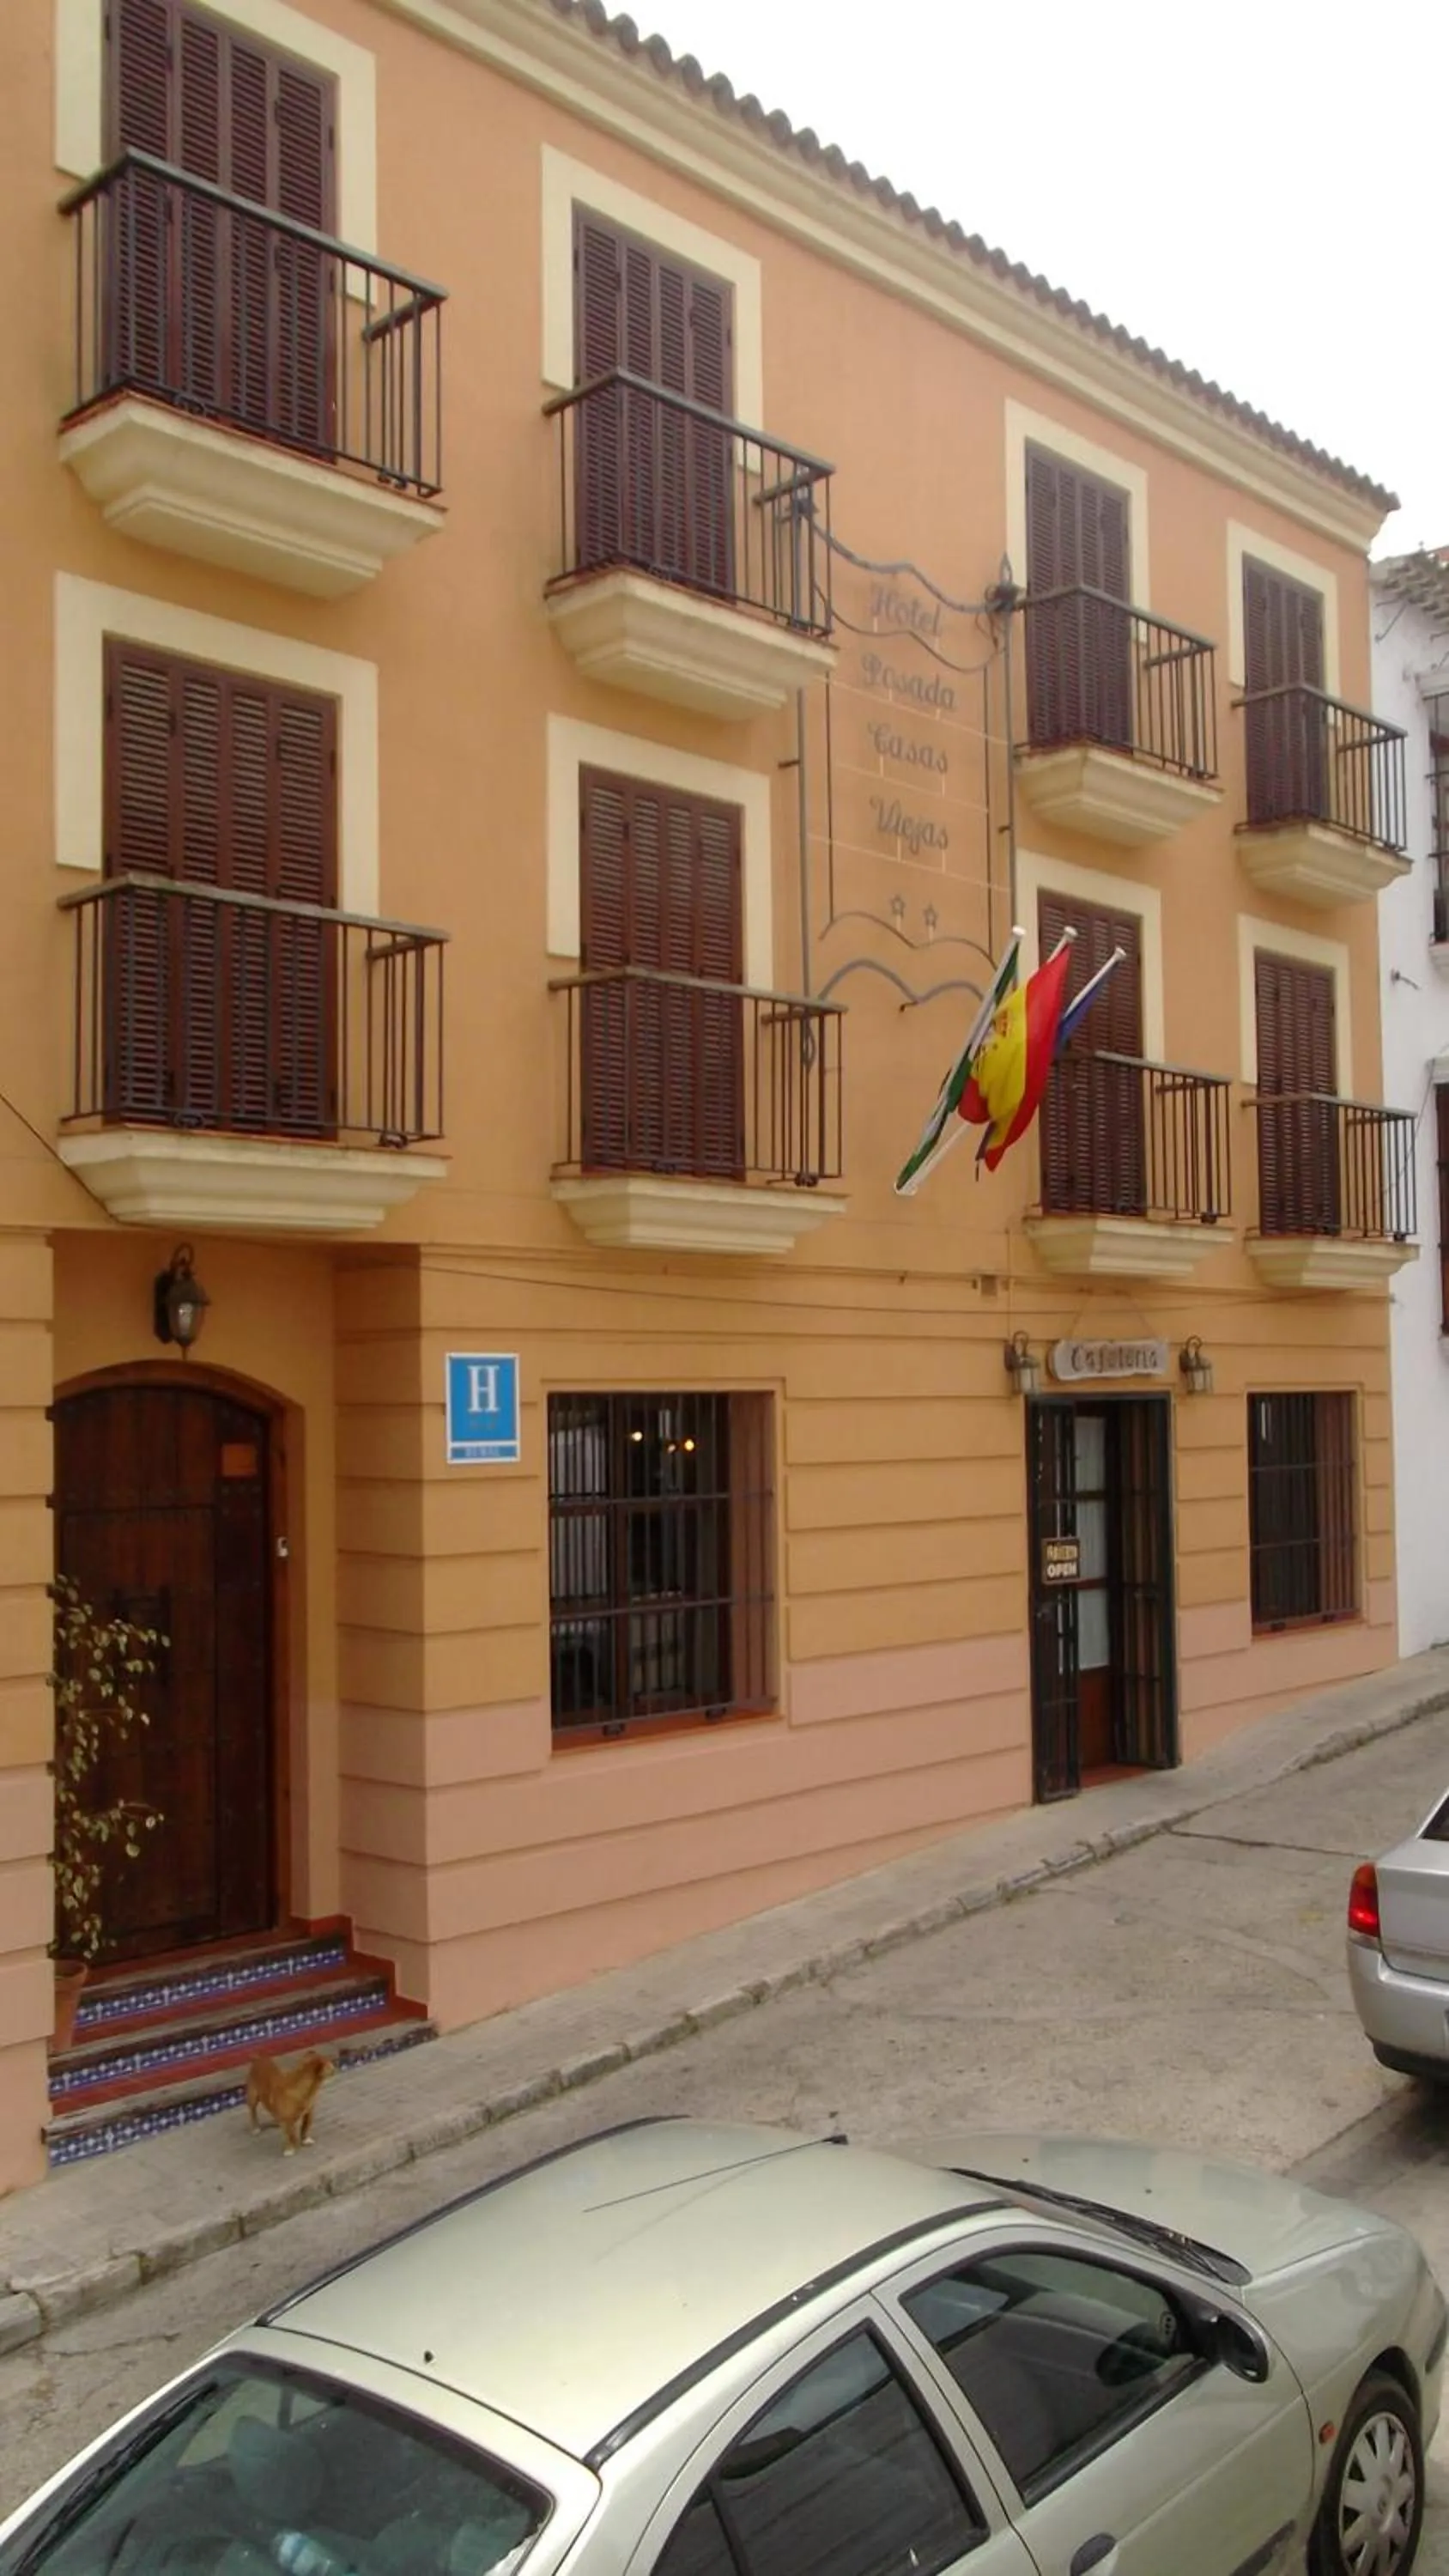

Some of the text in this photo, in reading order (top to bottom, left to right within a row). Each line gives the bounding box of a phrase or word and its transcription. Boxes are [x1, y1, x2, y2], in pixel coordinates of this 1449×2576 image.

[870, 581, 943, 638] Hotel
[861, 653, 955, 710] Posada
[868, 722, 949, 774] Casas
[870, 796, 949, 854] Viejas
[467, 1365, 500, 1413] H
[1046, 1562, 1077, 1578] OPEN
